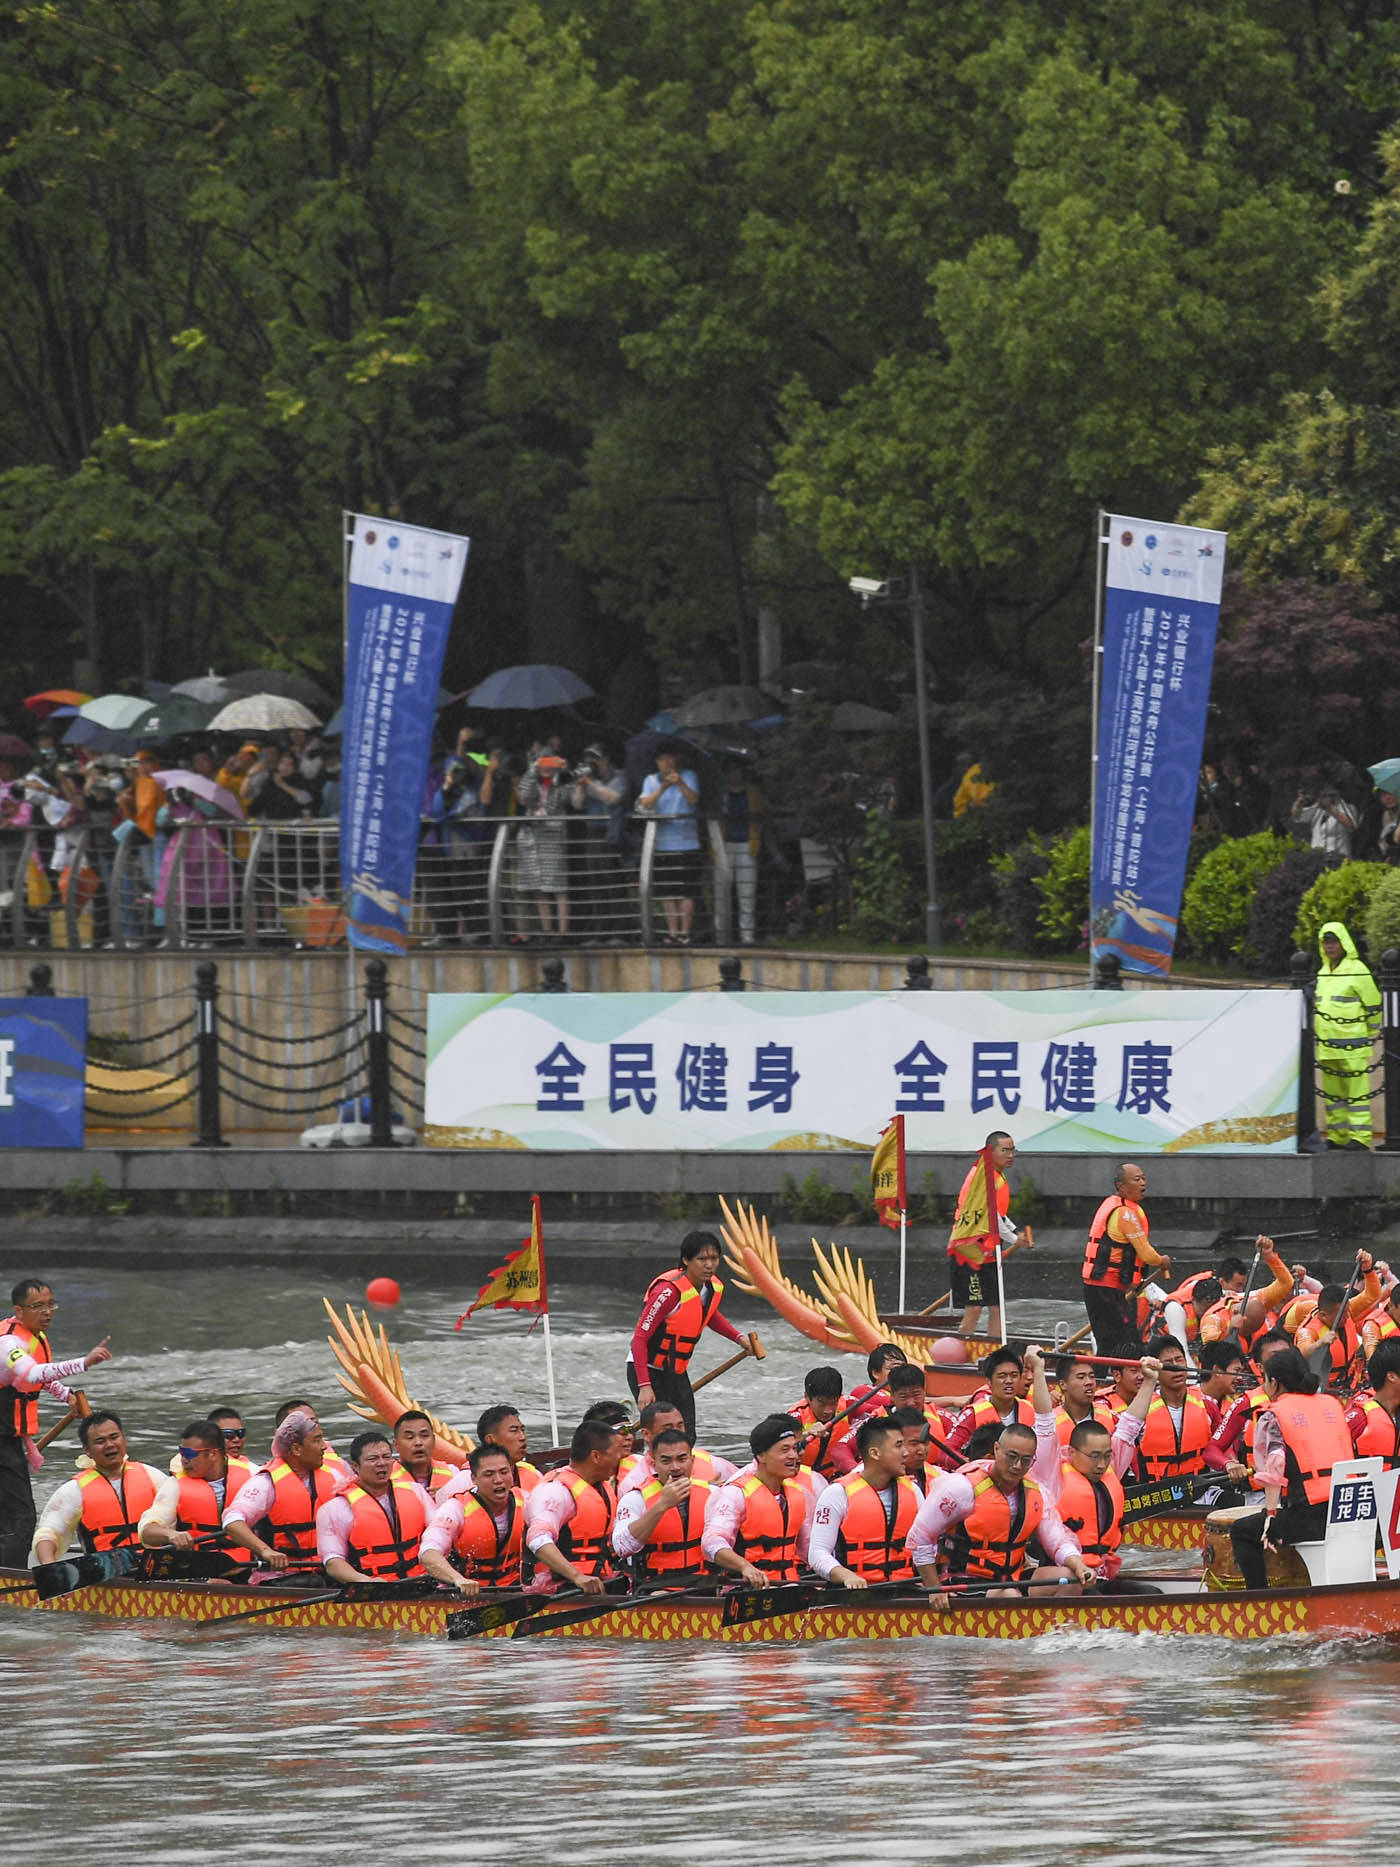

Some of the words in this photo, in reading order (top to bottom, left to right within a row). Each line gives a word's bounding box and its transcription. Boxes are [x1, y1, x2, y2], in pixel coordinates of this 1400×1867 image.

[534, 1041, 801, 1115] 全民健身
[893, 1040, 1174, 1115] 全民健康
[1290, 1408, 1337, 1428] 培生
[1338, 1484, 1374, 1502] 培生
[1336, 1501, 1372, 1521] 龙舟
